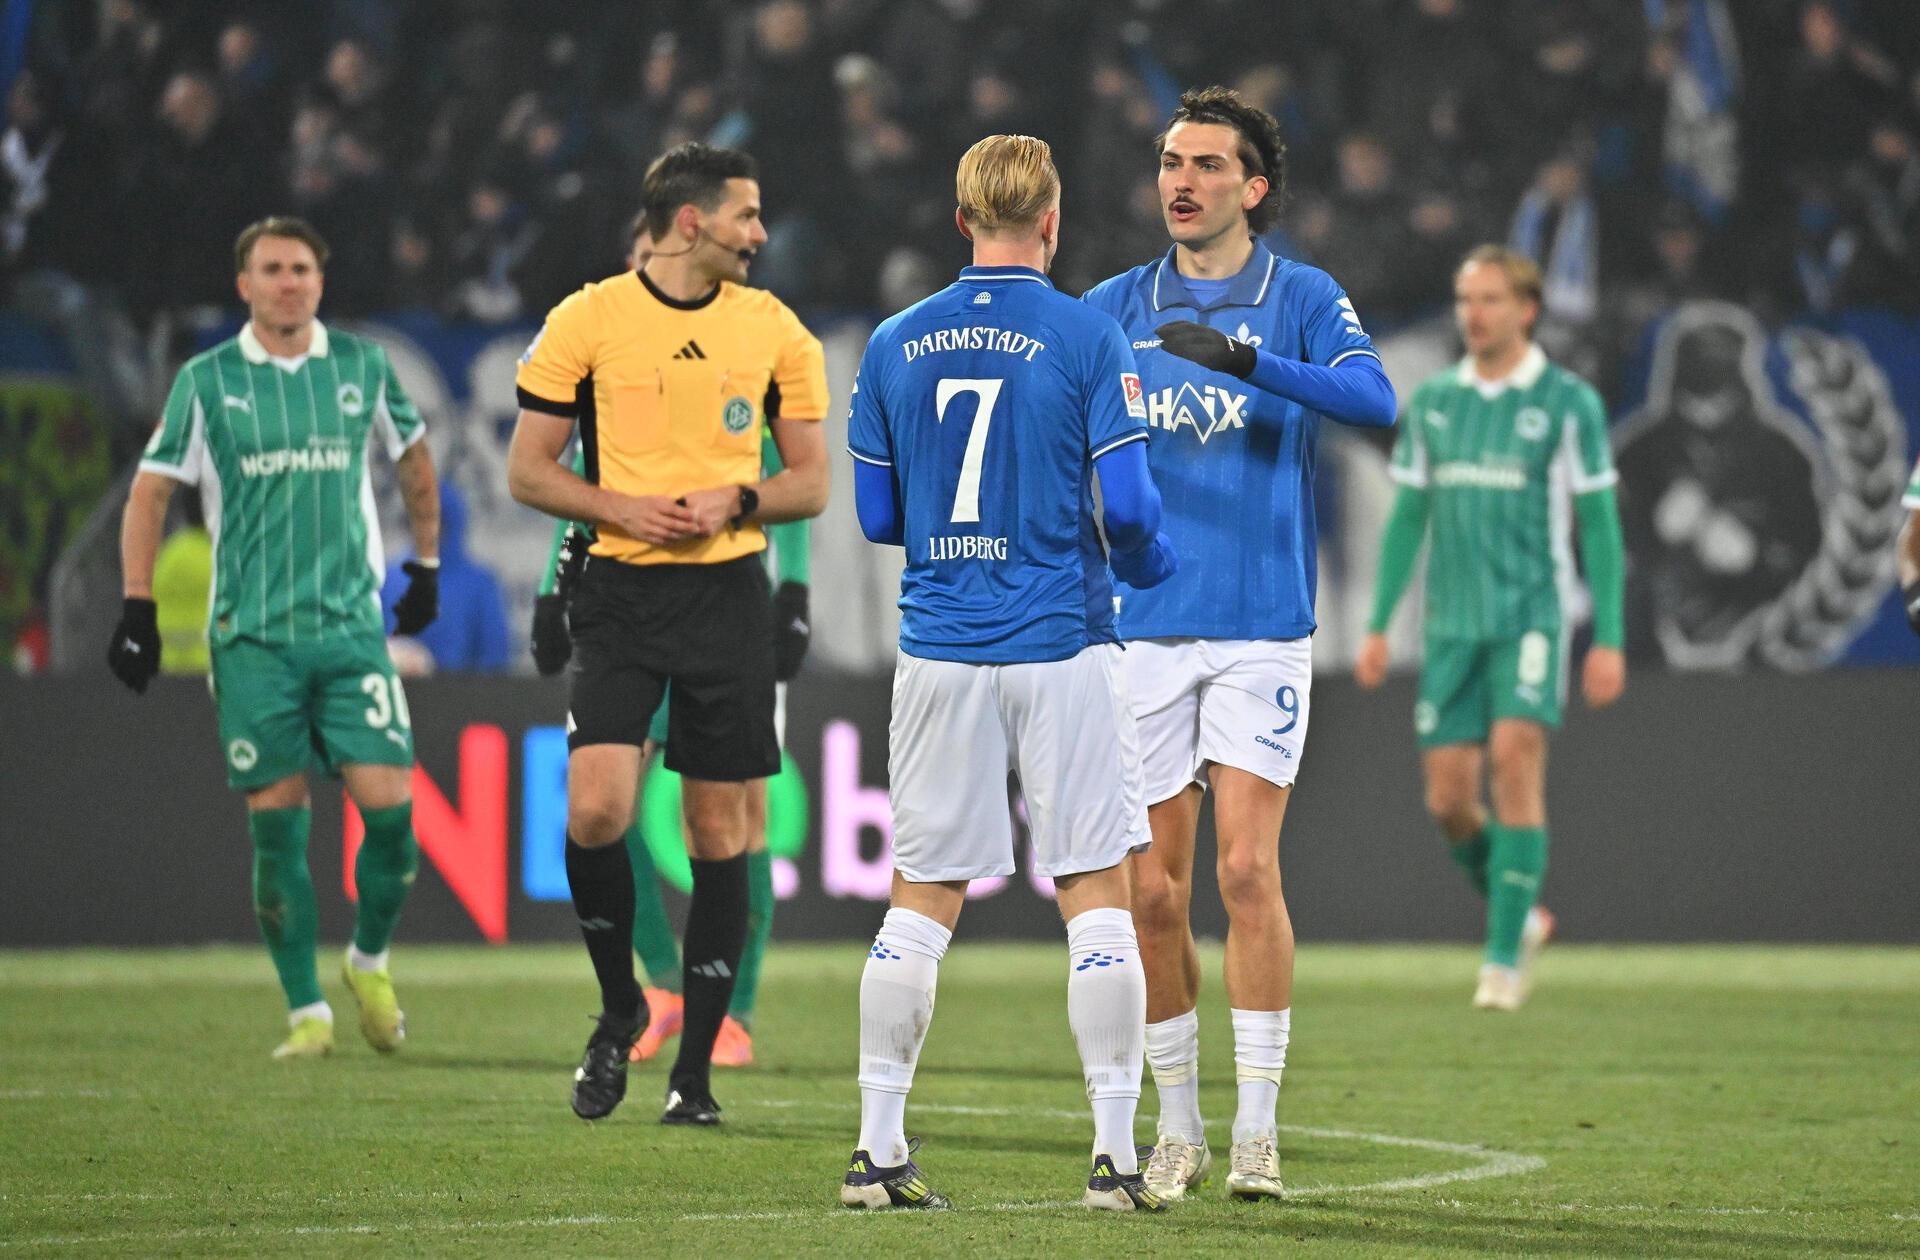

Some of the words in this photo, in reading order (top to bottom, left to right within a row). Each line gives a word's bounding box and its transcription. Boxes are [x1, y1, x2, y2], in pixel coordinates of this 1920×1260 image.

[903, 326, 1045, 363] DARMSTADT
[936, 378, 1004, 523] 7
[929, 535, 1008, 561] LIDBERG
[1272, 685, 1300, 735] 9
[1254, 735, 1288, 755] CRAFT
